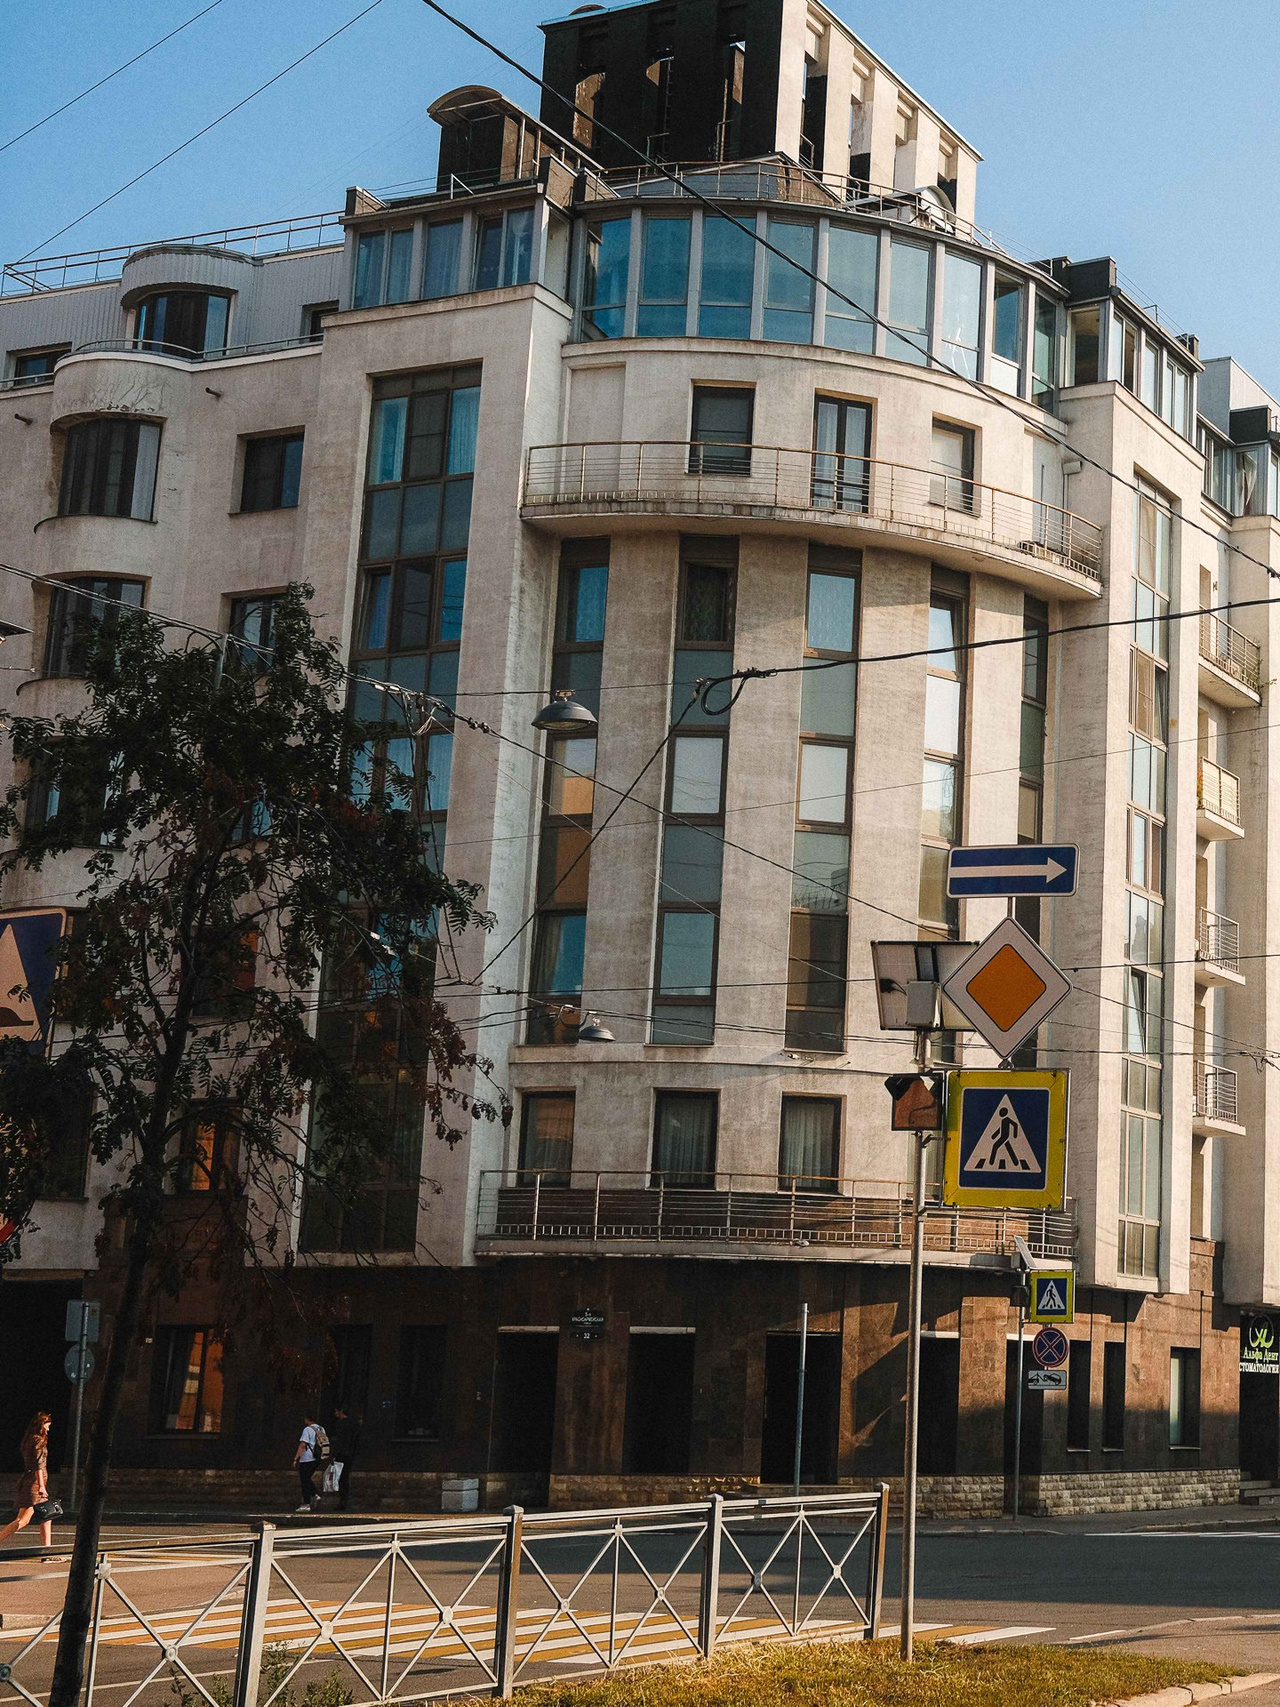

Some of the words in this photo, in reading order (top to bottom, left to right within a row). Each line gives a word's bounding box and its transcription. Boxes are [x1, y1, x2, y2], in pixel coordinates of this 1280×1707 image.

[1243, 1347, 1263, 1363] Альфа
[1263, 1349, 1279, 1363] Дент
[1239, 1362, 1279, 1374] СТОМАТОЛОГИЯ
